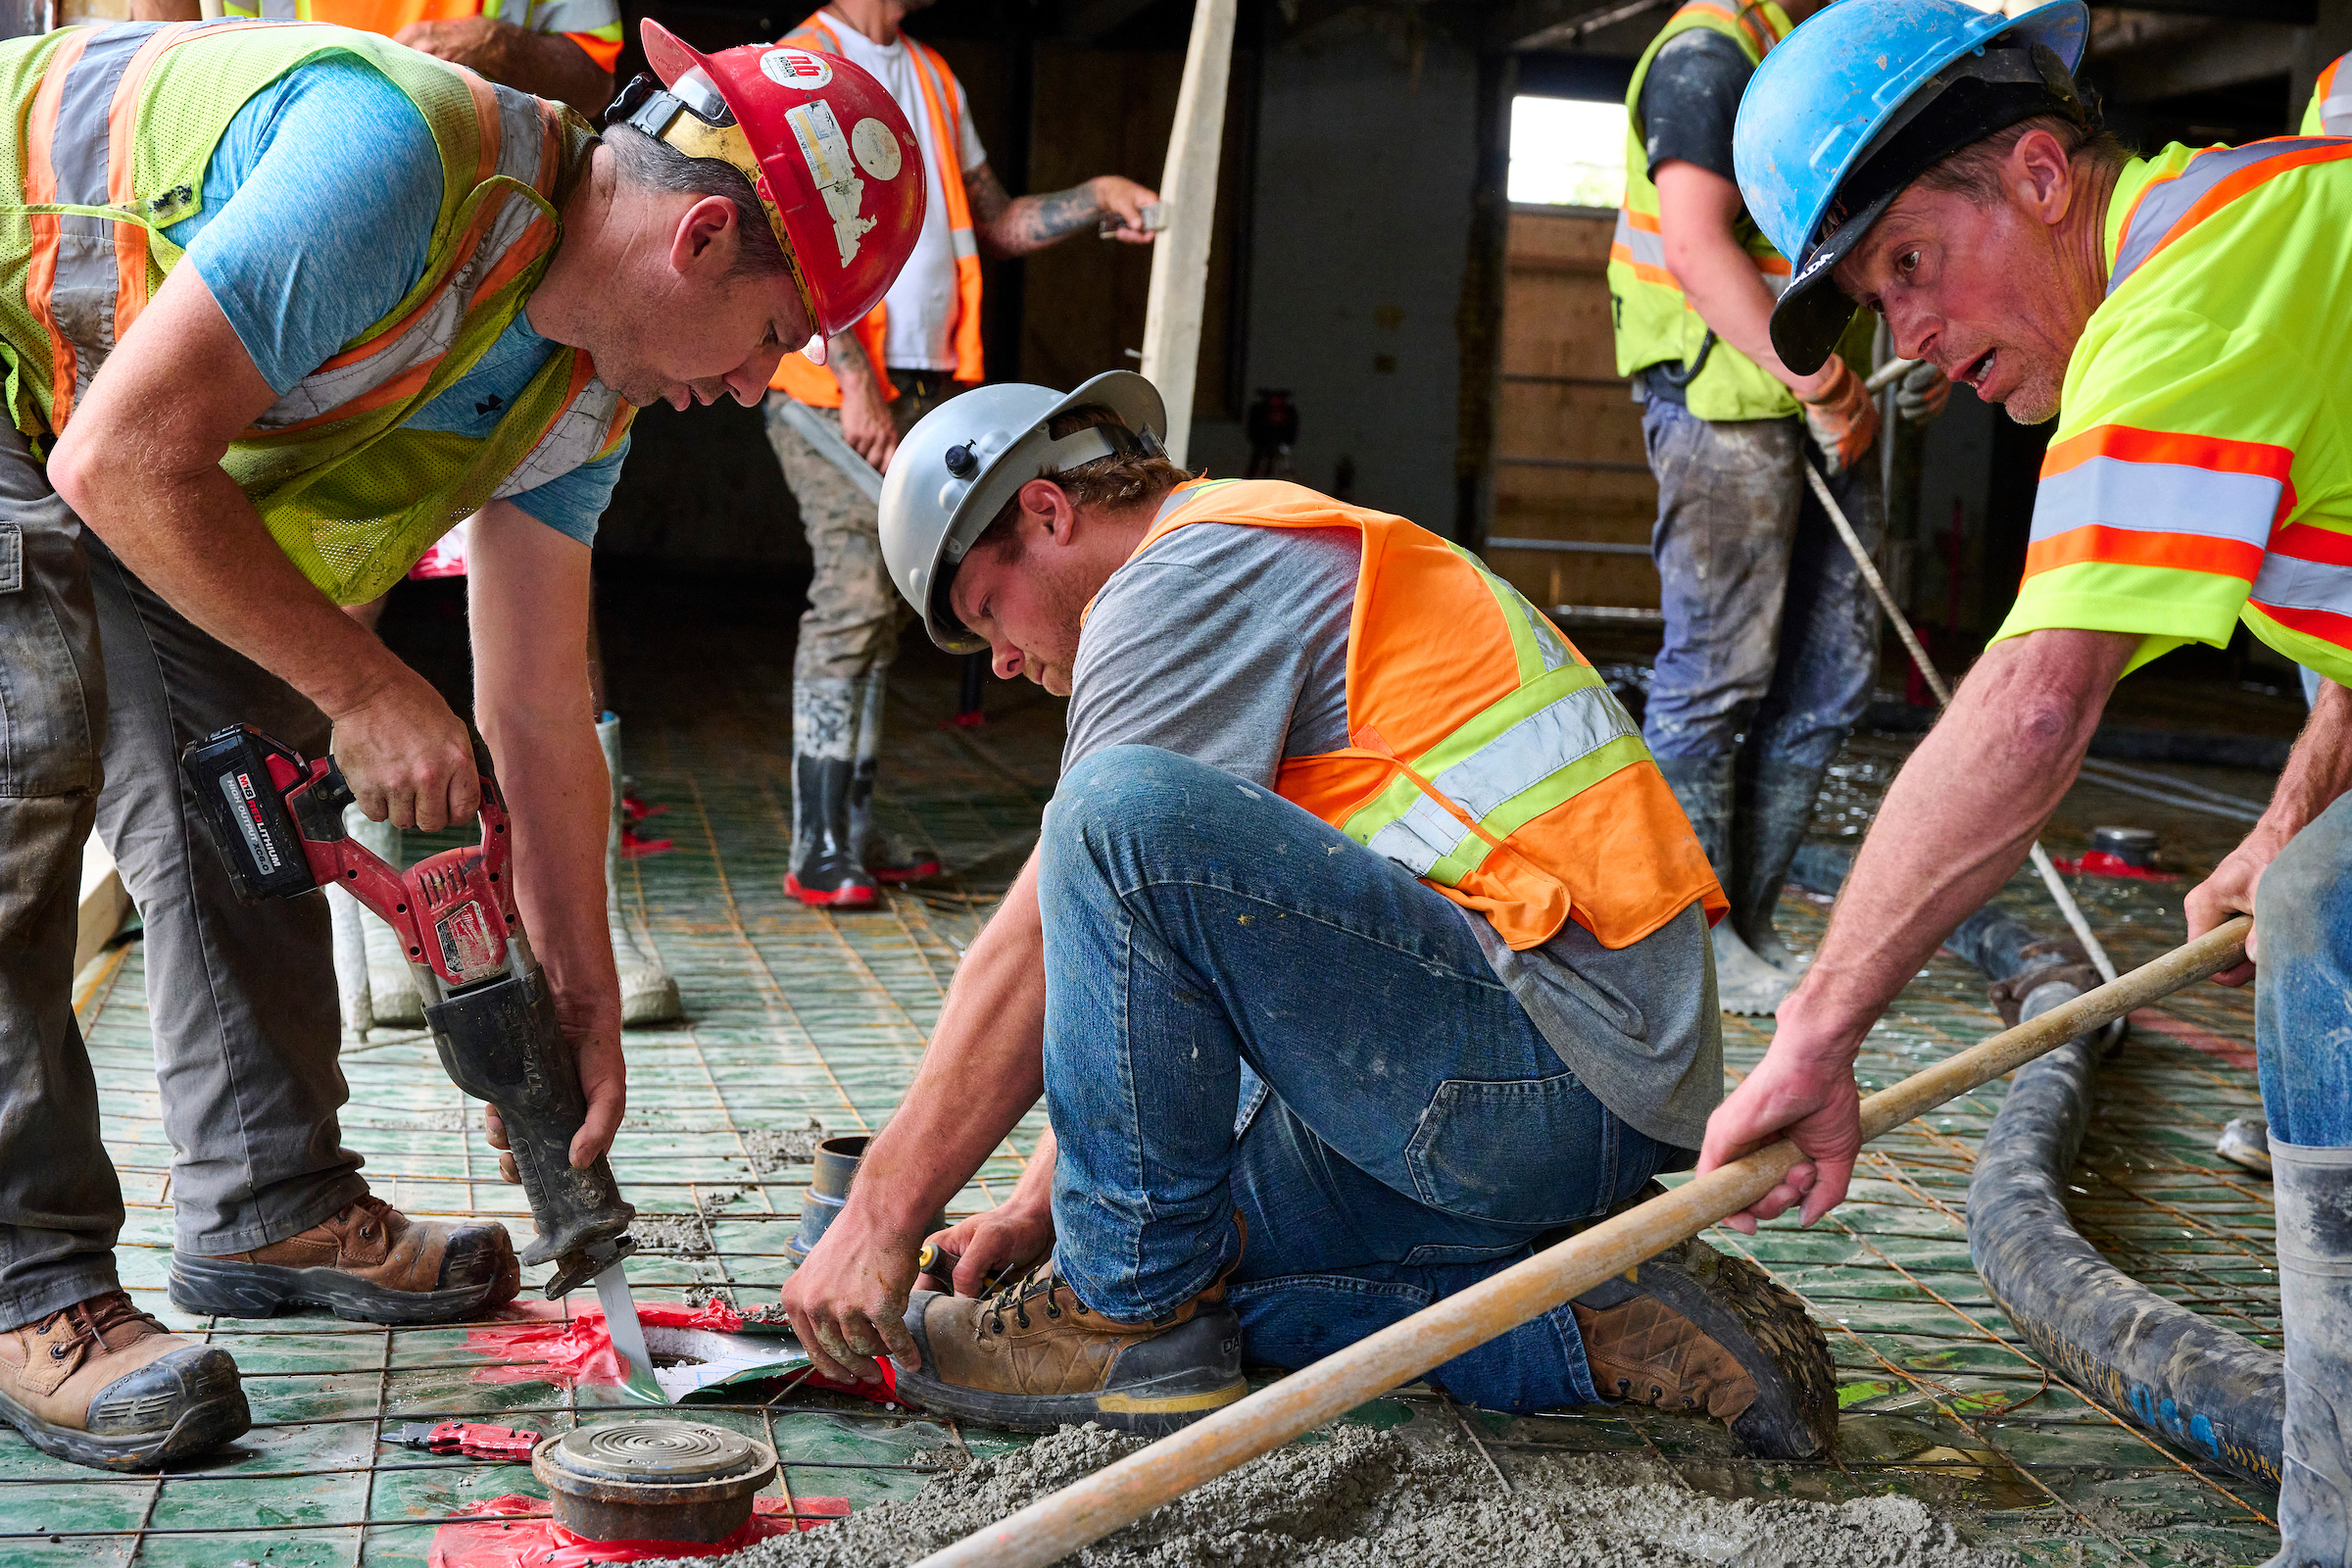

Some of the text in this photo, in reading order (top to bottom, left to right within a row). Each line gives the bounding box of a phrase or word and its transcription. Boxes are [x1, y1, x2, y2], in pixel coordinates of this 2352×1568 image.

[778, 56, 797, 77] NORLON
[801, 142, 817, 172] VERIFIED
[226, 779, 242, 804] HIGH
[237, 805, 259, 842] OUTPUT
[239, 775, 281, 867] M18 REDLITHIUM
